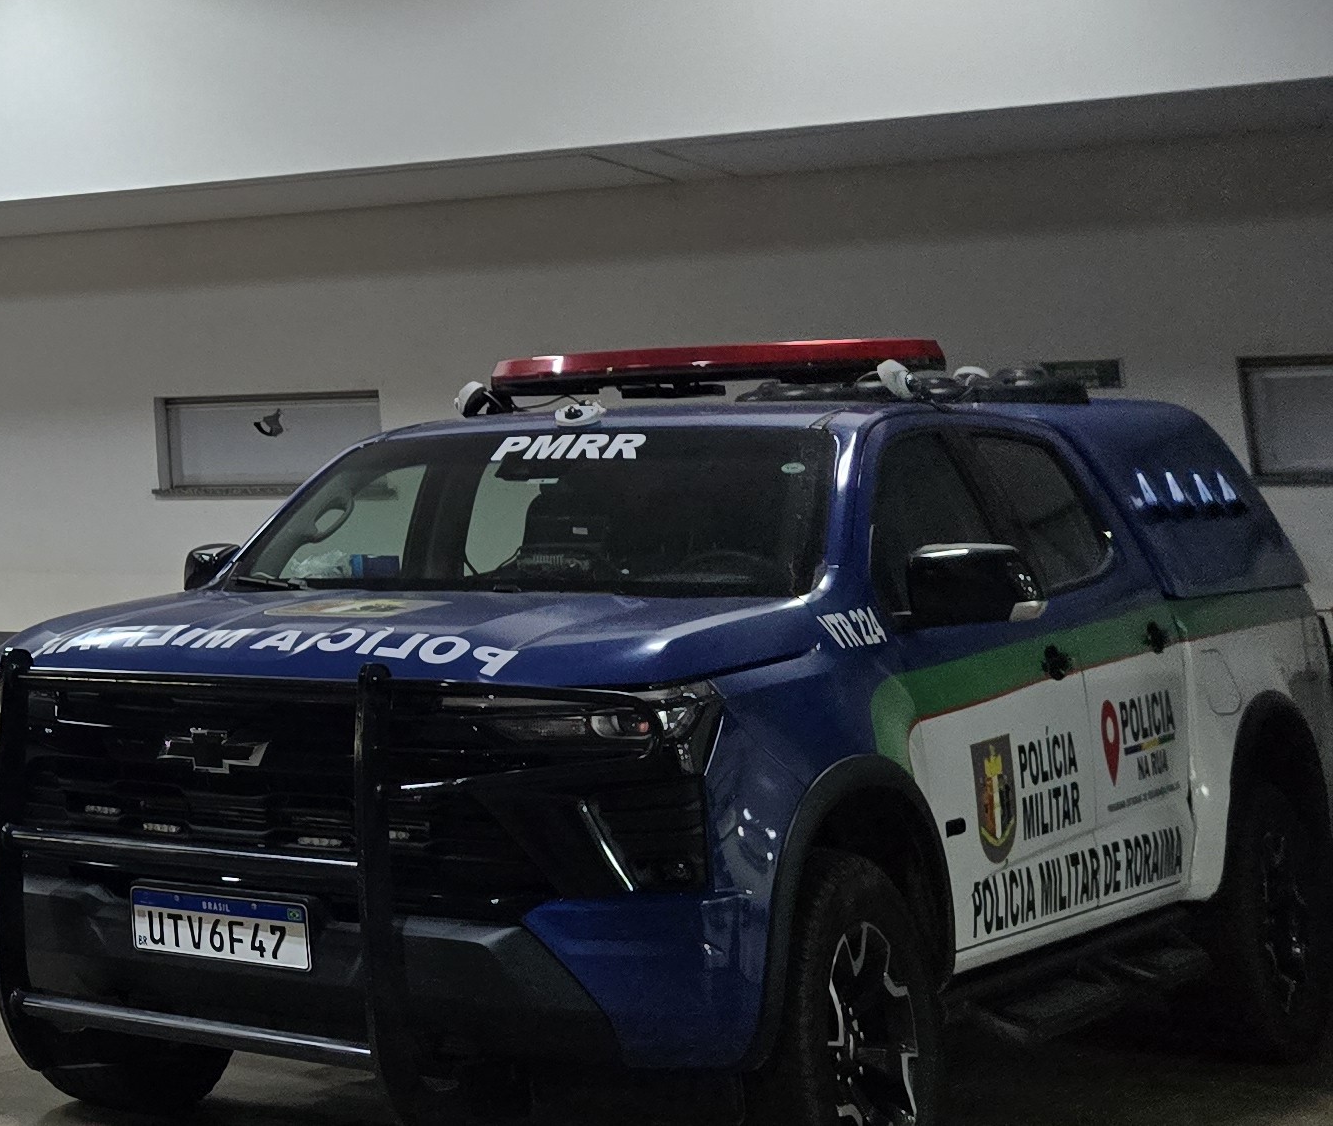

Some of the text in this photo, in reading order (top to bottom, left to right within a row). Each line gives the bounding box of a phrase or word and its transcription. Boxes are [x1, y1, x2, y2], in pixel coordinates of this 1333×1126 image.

[490, 433, 647, 461] PMRR
[816, 606, 887, 649] VTR 224
[1018, 725, 1078, 789] POLÍCIA
[1136, 755, 1151, 781] NA
[1022, 781, 1082, 841] MILITAR
[972, 826, 1183, 938] POLÍCIA MILITAR DE RORAIMA
[201, 900, 231, 913] BRASIL
[138, 935, 148, 946] BR
[147, 910, 287, 960] UTV6F47
